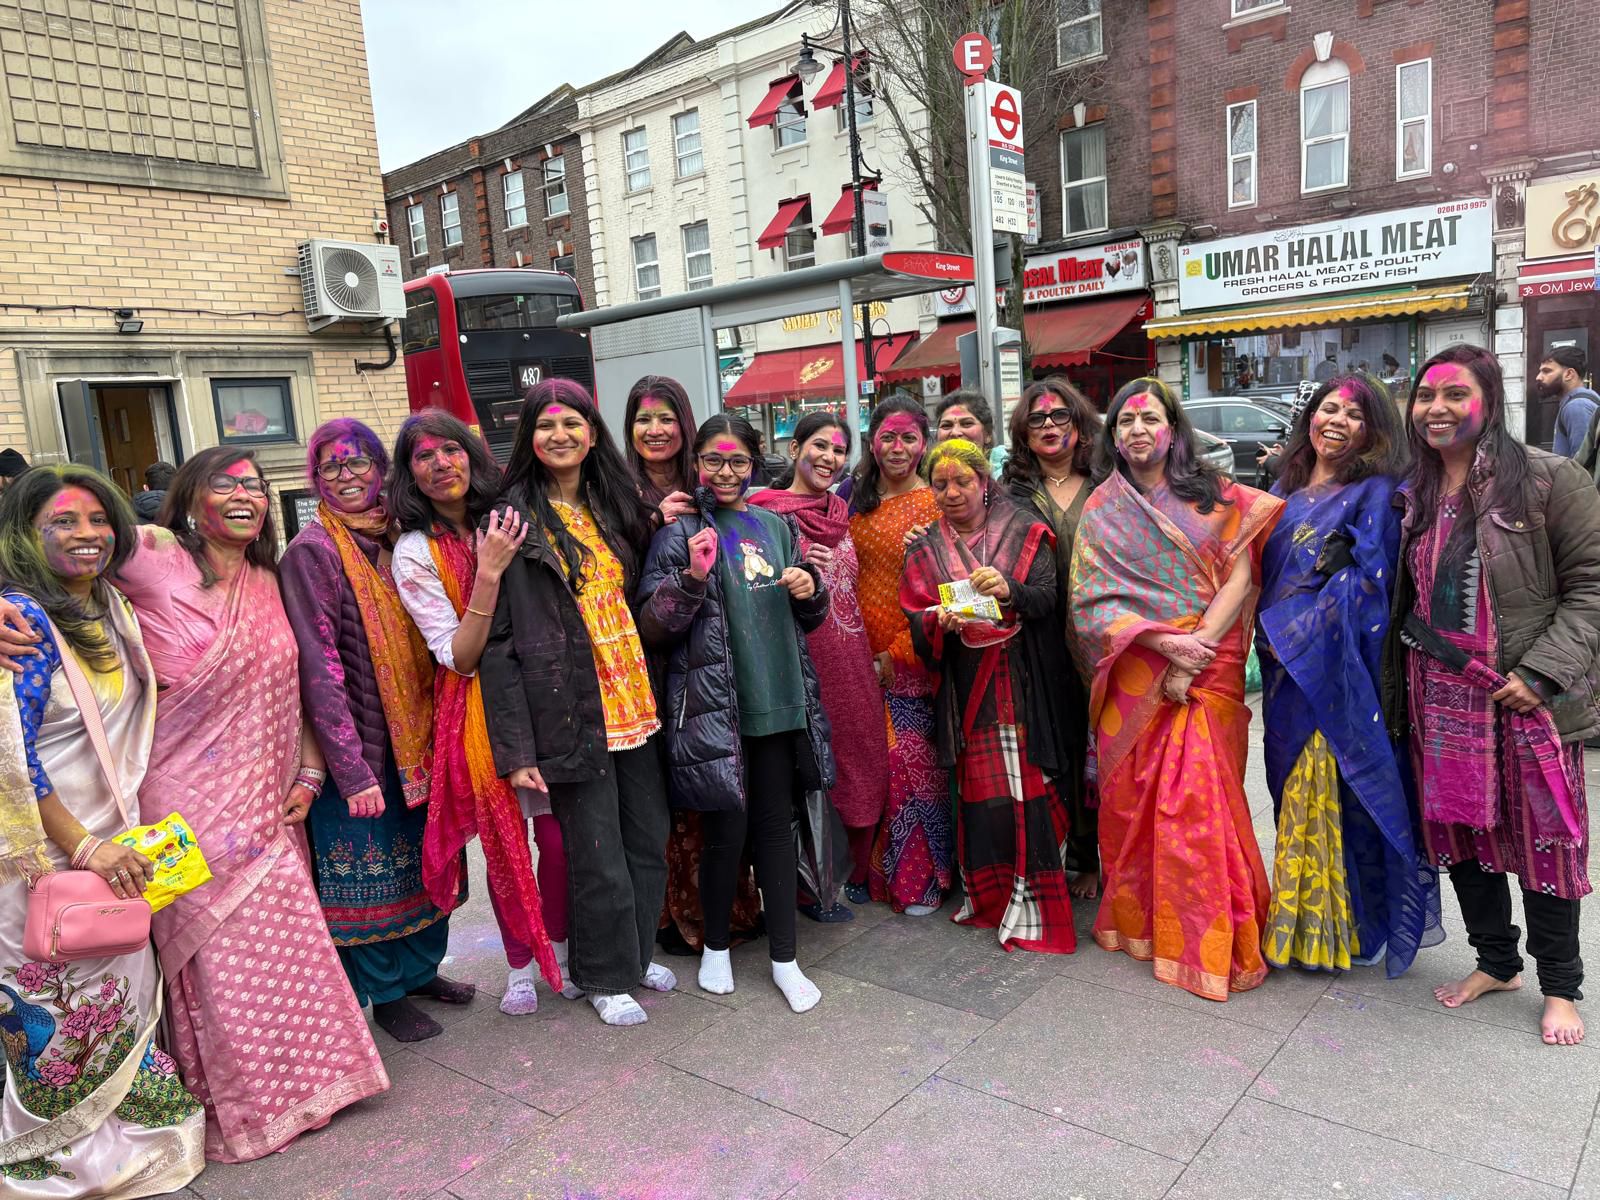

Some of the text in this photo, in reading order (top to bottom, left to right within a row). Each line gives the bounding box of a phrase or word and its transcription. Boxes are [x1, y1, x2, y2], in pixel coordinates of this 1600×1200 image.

[964, 40, 984, 70] E
[1437, 206, 1455, 214] 0208
[1456, 203, 1469, 212] 813
[1206, 244, 1280, 280] UMAR
[1288, 229, 1373, 268] HALAL
[1382, 215, 1462, 256] MEAT
[935, 262, 947, 271] King
[947, 263, 961, 271] Street
[1058, 256, 1105, 283] MEAT
[1223, 251, 1442, 289] FRESH HALAL MEAT & POULTRY
[1028, 291, 1035, 300] &
[1037, 286, 1076, 300] POULTRY
[1078, 281, 1106, 294] DAILY
[1242, 266, 1418, 296] GROCERS & FROZEN FISH
[1539, 280, 1595, 295] OM Jew
